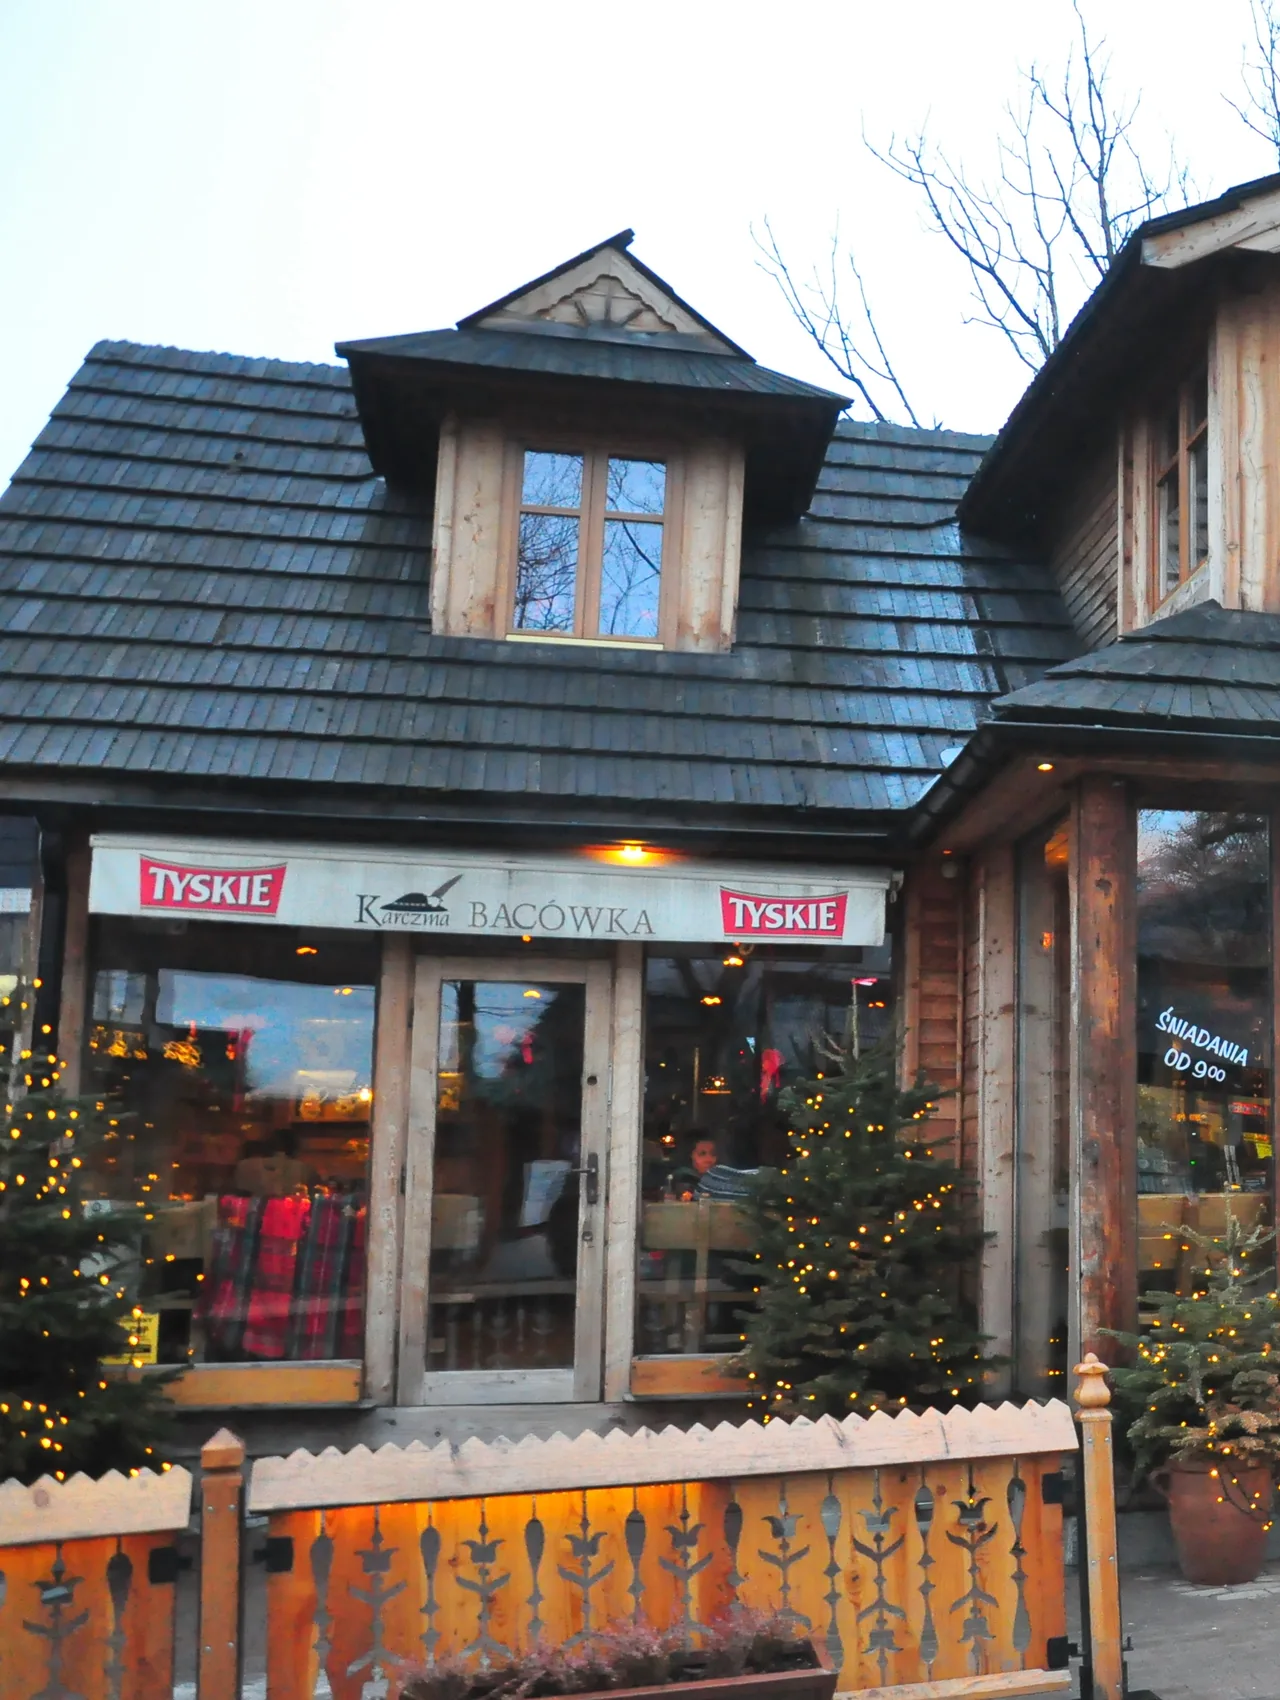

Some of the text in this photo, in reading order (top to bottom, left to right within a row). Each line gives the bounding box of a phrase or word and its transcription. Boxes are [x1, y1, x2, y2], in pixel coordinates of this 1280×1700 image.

[149, 866, 273, 906] TYSKIE
[354, 894, 656, 936] Karczma BACÓWKA
[729, 897, 837, 931] TYSKIE
[1155, 1006, 1249, 1067] ŚNIADANIA
[1164, 1047, 1191, 1071] OD
